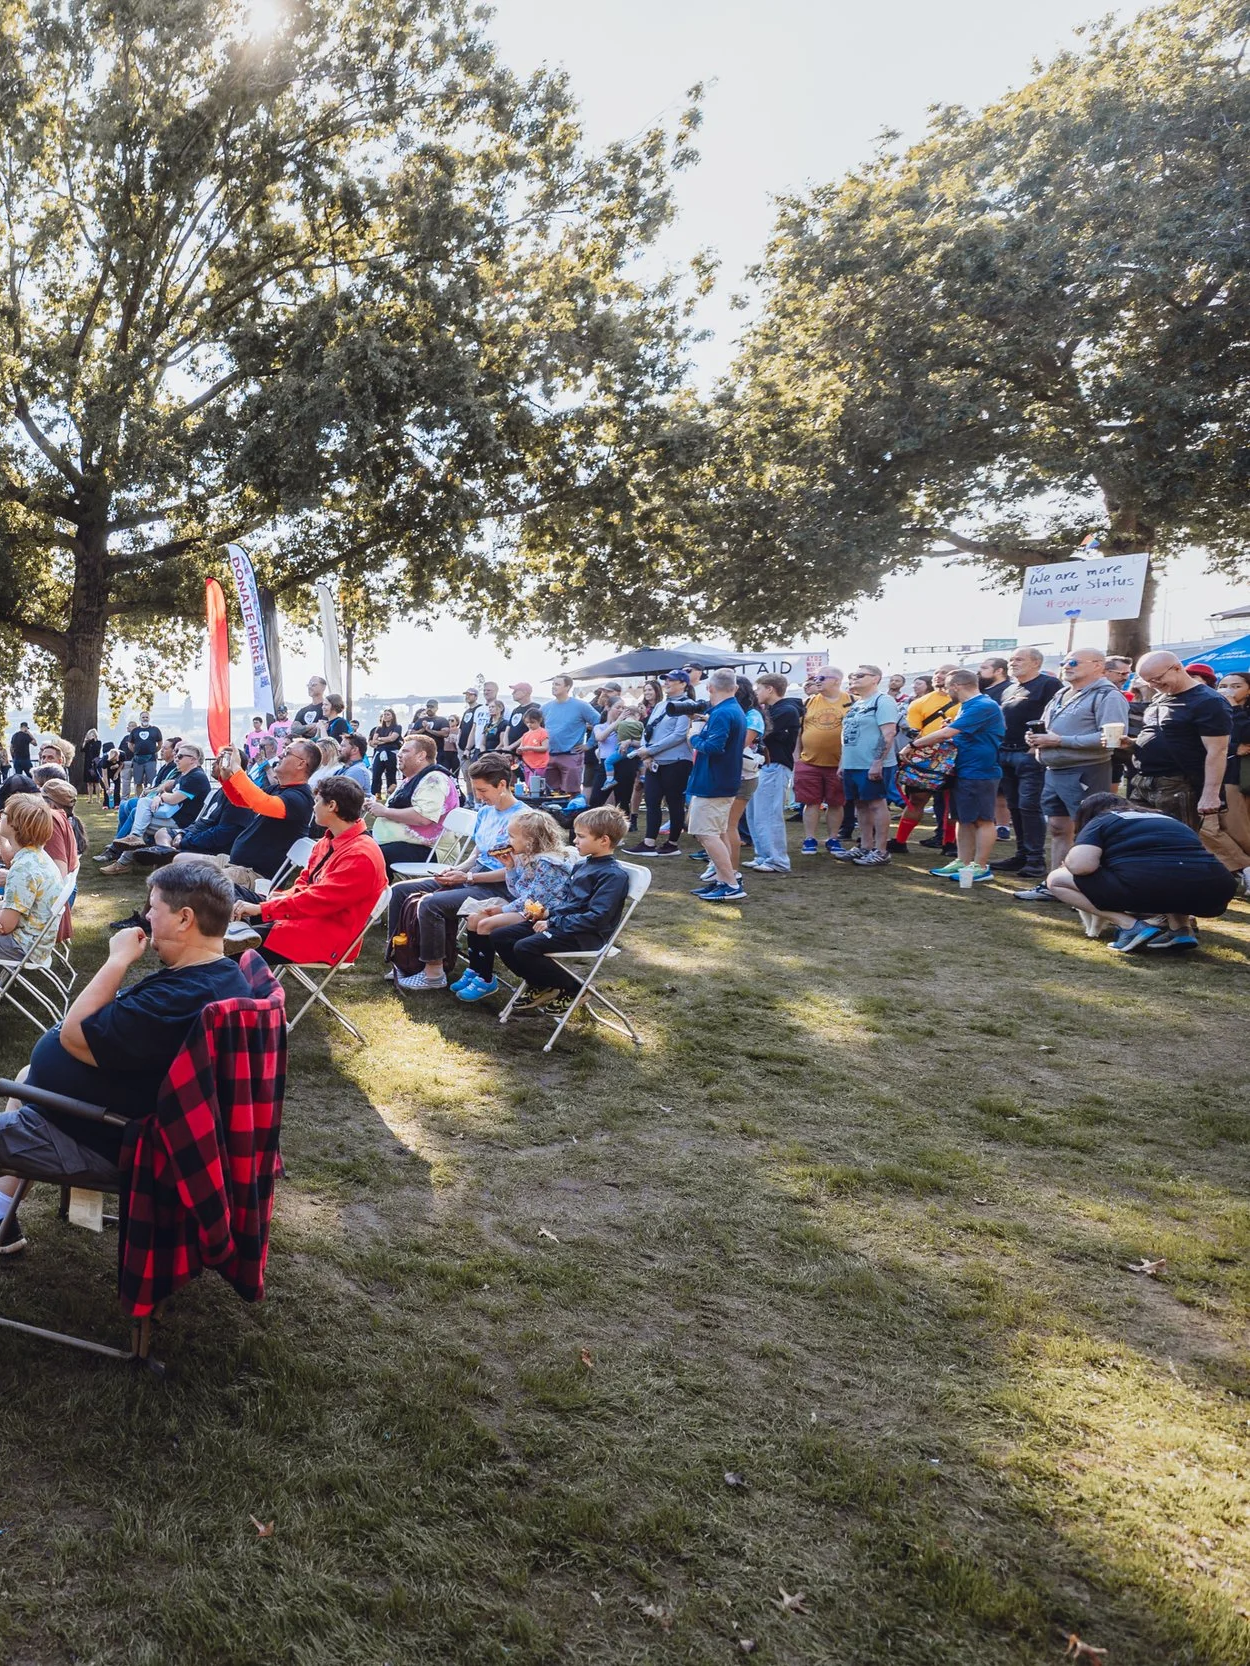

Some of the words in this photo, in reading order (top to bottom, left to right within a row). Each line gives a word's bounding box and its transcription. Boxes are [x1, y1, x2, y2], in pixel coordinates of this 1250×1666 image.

[1030, 573, 1050, 585] We
[1055, 571, 1078, 581] are
[1086, 564, 1122, 577] more
[1025, 587, 1053, 597] than
[1060, 583, 1081, 594] our
[232, 556, 255, 622] DONATE
[247, 625, 260, 664] HERE
[756, 661, 792, 675] AID
